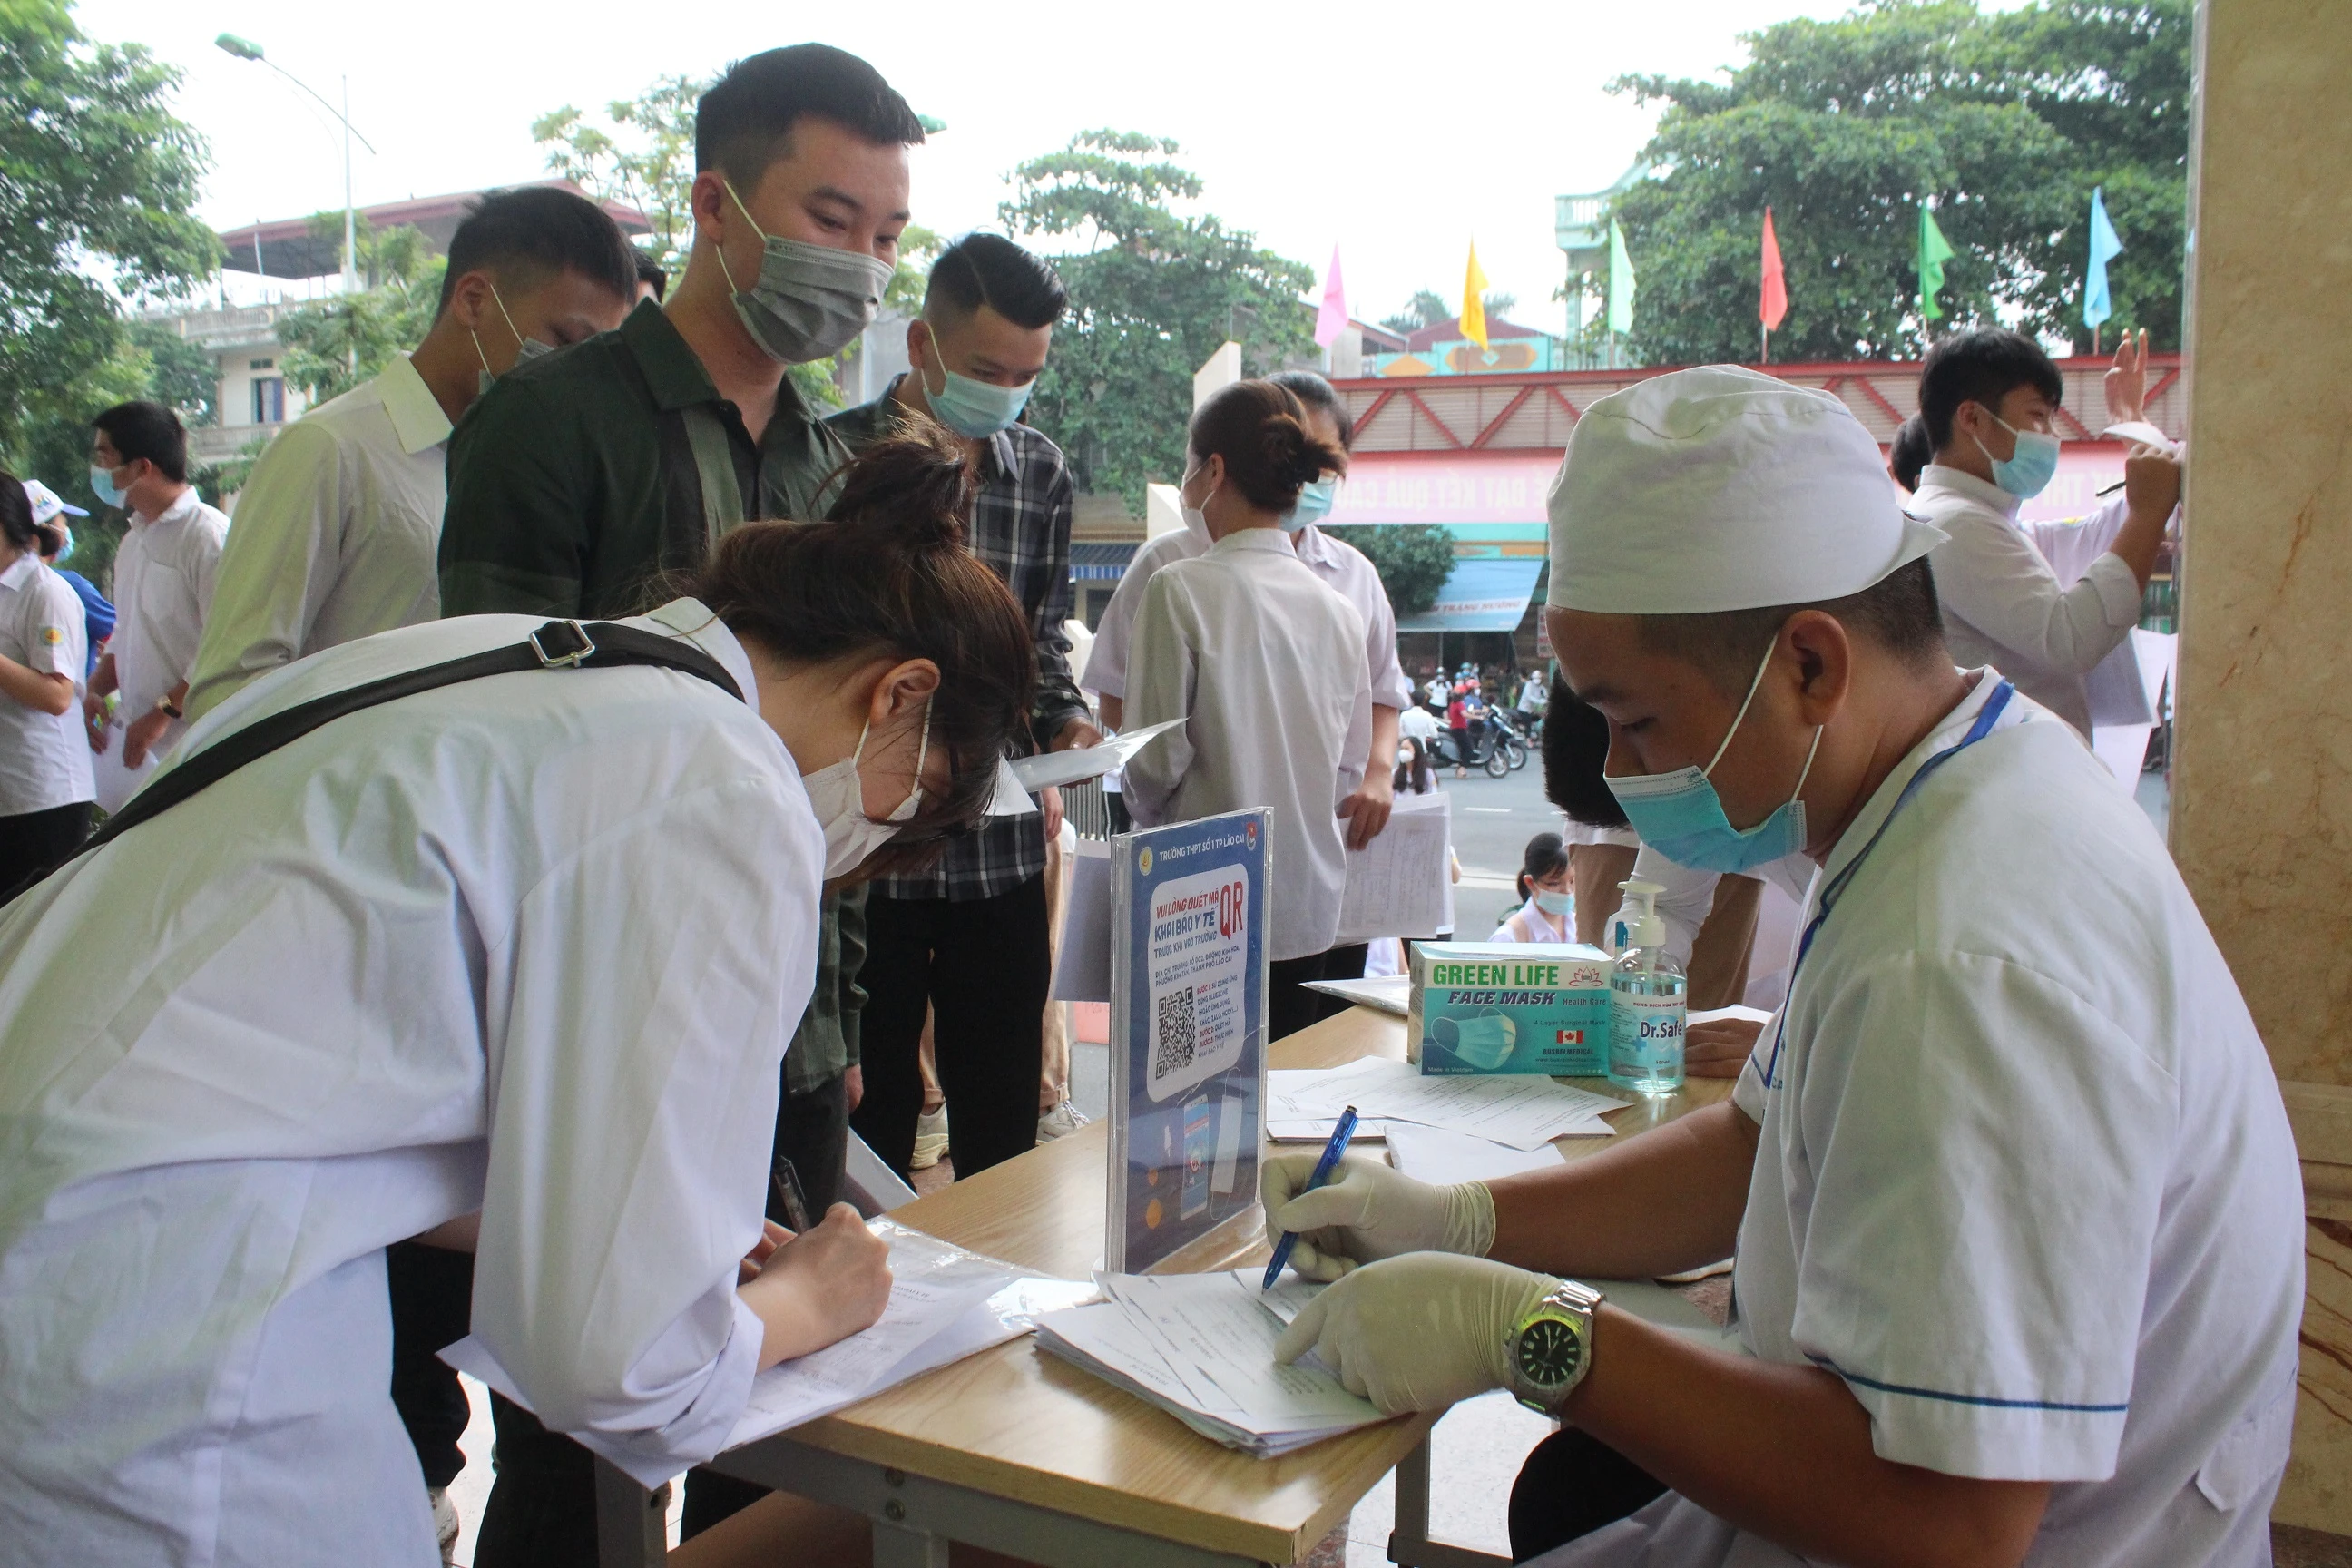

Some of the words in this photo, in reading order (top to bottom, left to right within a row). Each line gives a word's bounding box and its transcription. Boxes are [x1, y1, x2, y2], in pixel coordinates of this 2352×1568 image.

[1160, 846, 1185, 861] TRƯỜNG
[1187, 843, 1201, 856] THPT
[1202, 837, 1210, 852] SỐ
[1211, 840, 1214, 849] 1
[1216, 838, 1222, 848] TP
[1223, 834, 1234, 848] LÀO
[1236, 834, 1245, 844] CAI
[1157, 905, 1167, 919] VUI
[1168, 897, 1187, 916] LÒNG
[1188, 890, 1208, 910] QUÉT
[1209, 887, 1219, 904] MÃ
[1220, 881, 1243, 940] QR
[1155, 920, 1175, 942] KHAI
[1176, 911, 1193, 936] BÁO
[1195, 914, 1201, 929] Y
[1203, 906, 1218, 927] TẾ
[1173, 942, 1183, 953] KHI
[1195, 929, 1218, 946] TRƯỜNG
[1433, 965, 1507, 985] GREEN
[1514, 965, 1559, 985] LIFE
[1448, 991, 1497, 1005] FACE
[1499, 992, 1556, 1005] MASK
[1641, 1020, 1682, 1039] Dr.Safe
